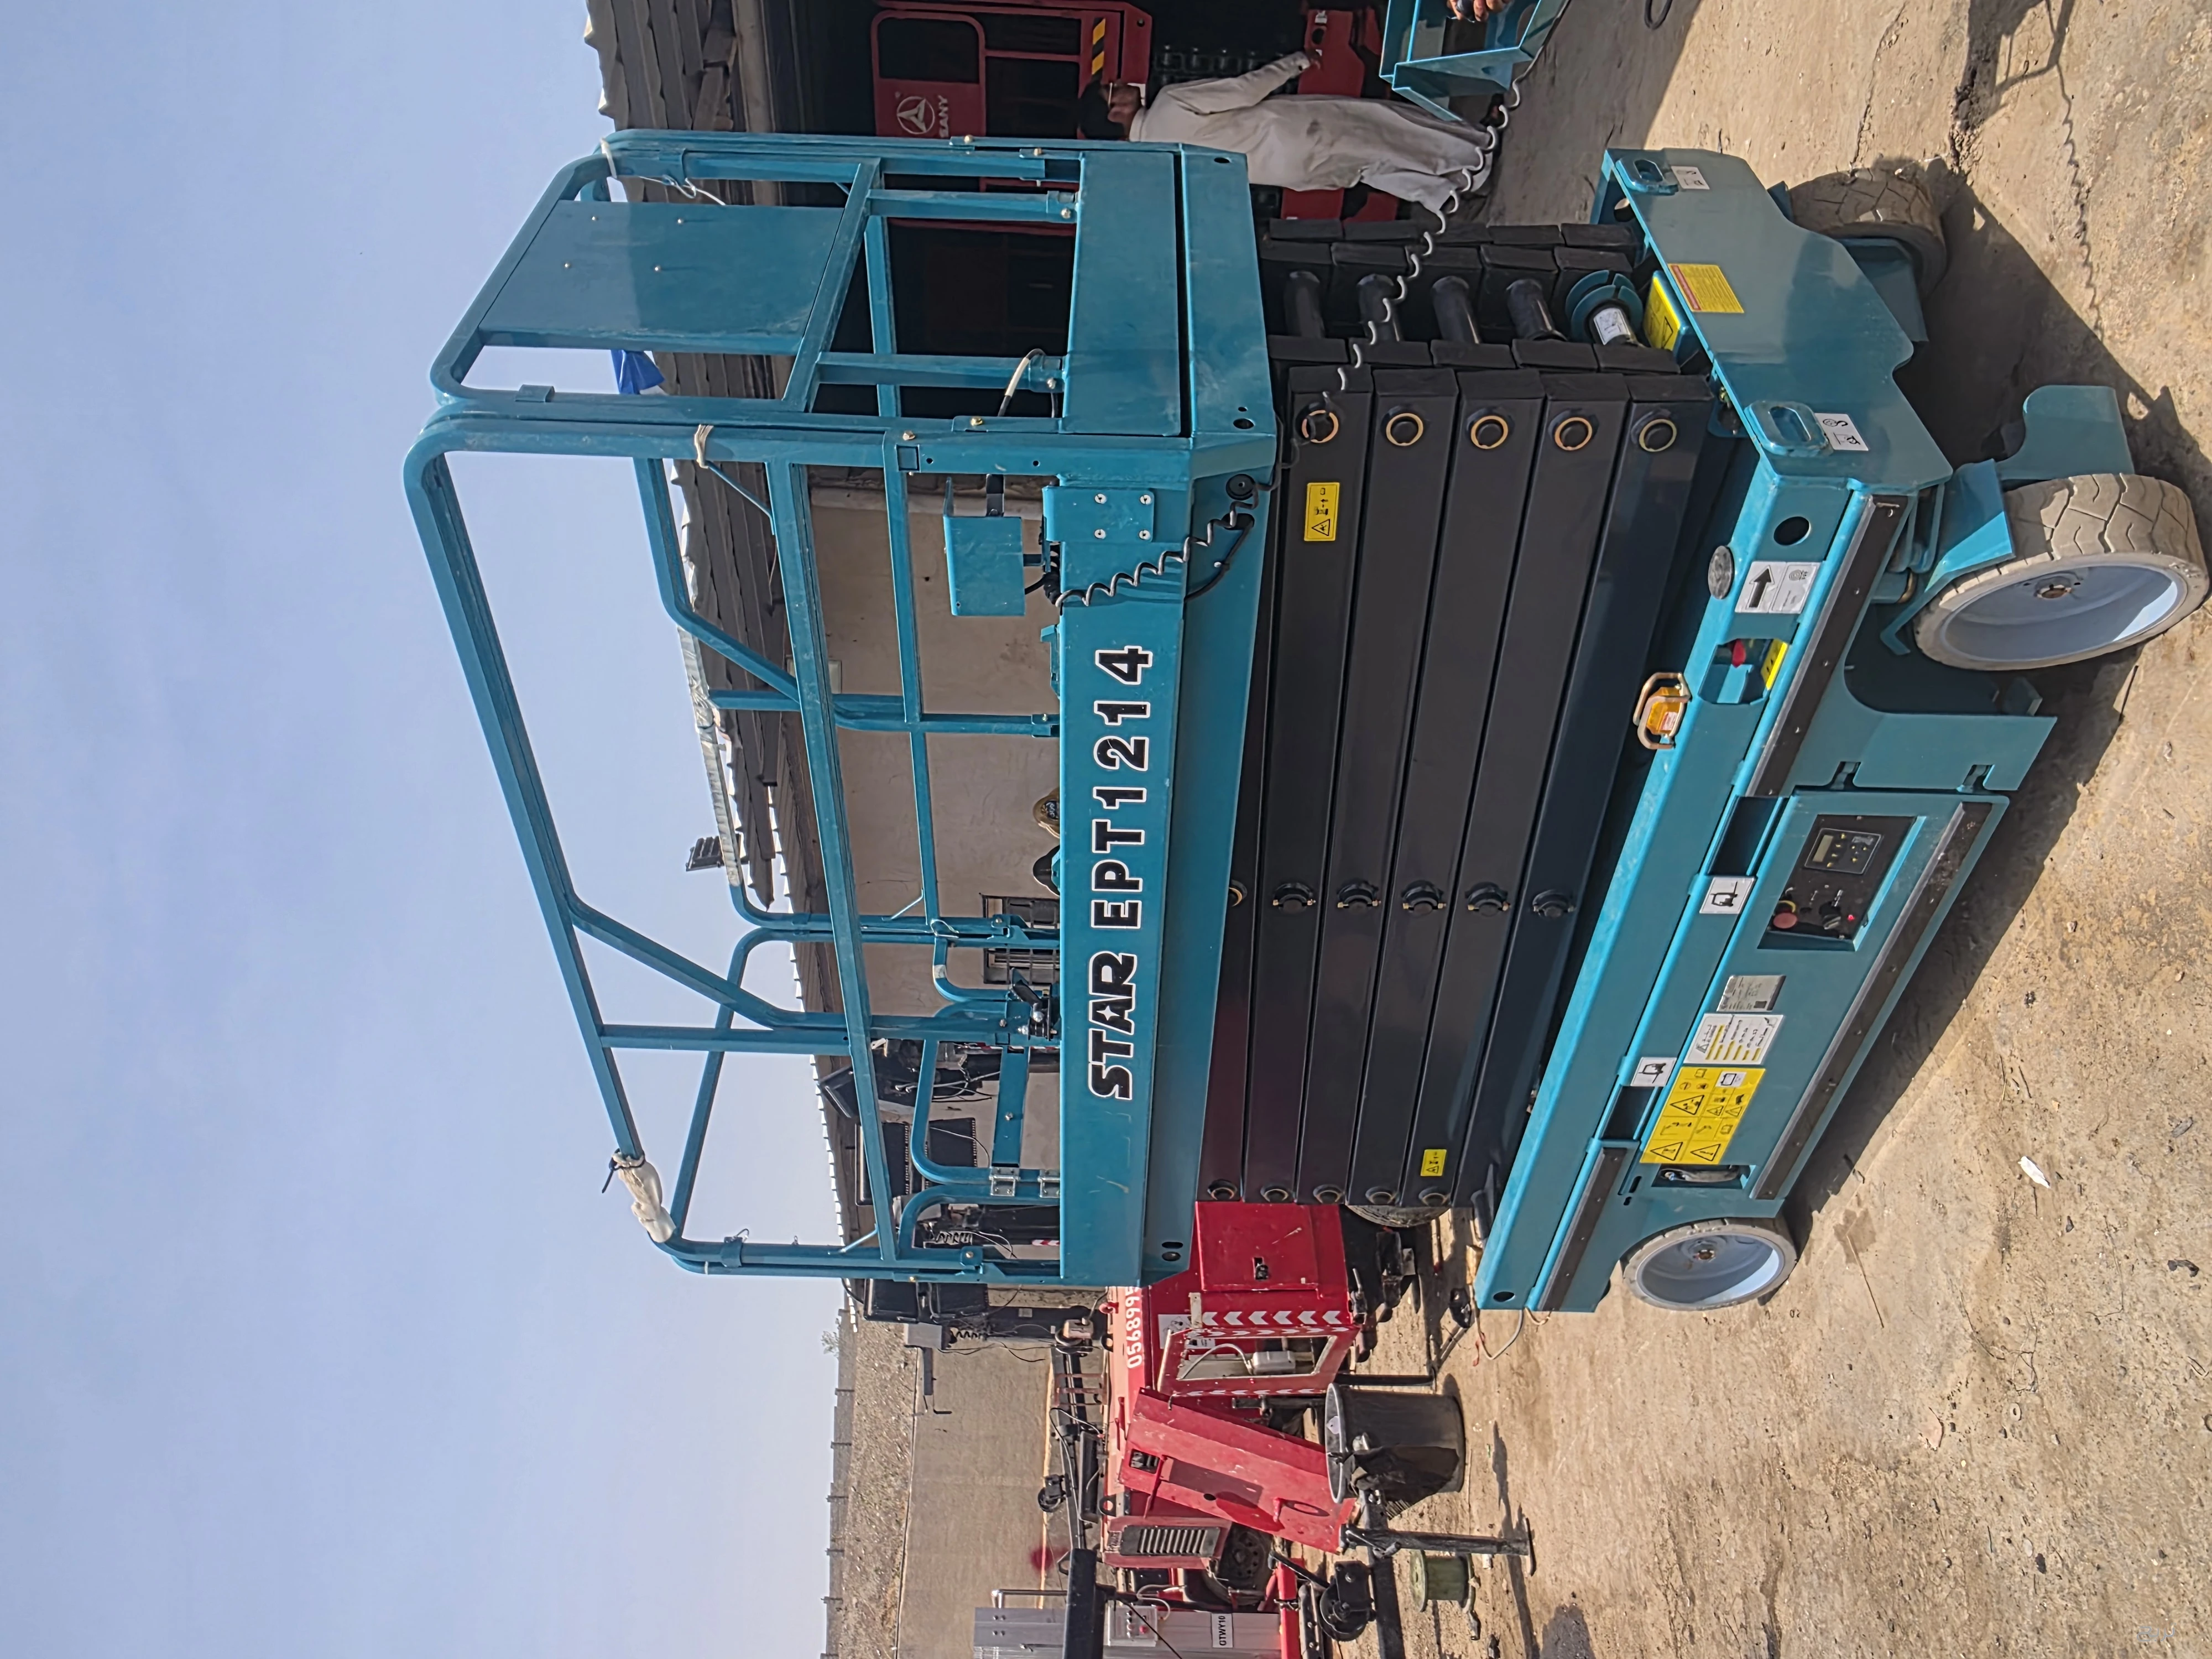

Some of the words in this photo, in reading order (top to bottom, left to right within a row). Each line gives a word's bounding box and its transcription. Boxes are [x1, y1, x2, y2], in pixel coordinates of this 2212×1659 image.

[938, 95, 949, 138] SANY
[1091, 645, 1153, 930] EPT1214
[1088, 951, 1138, 1100] STAR
